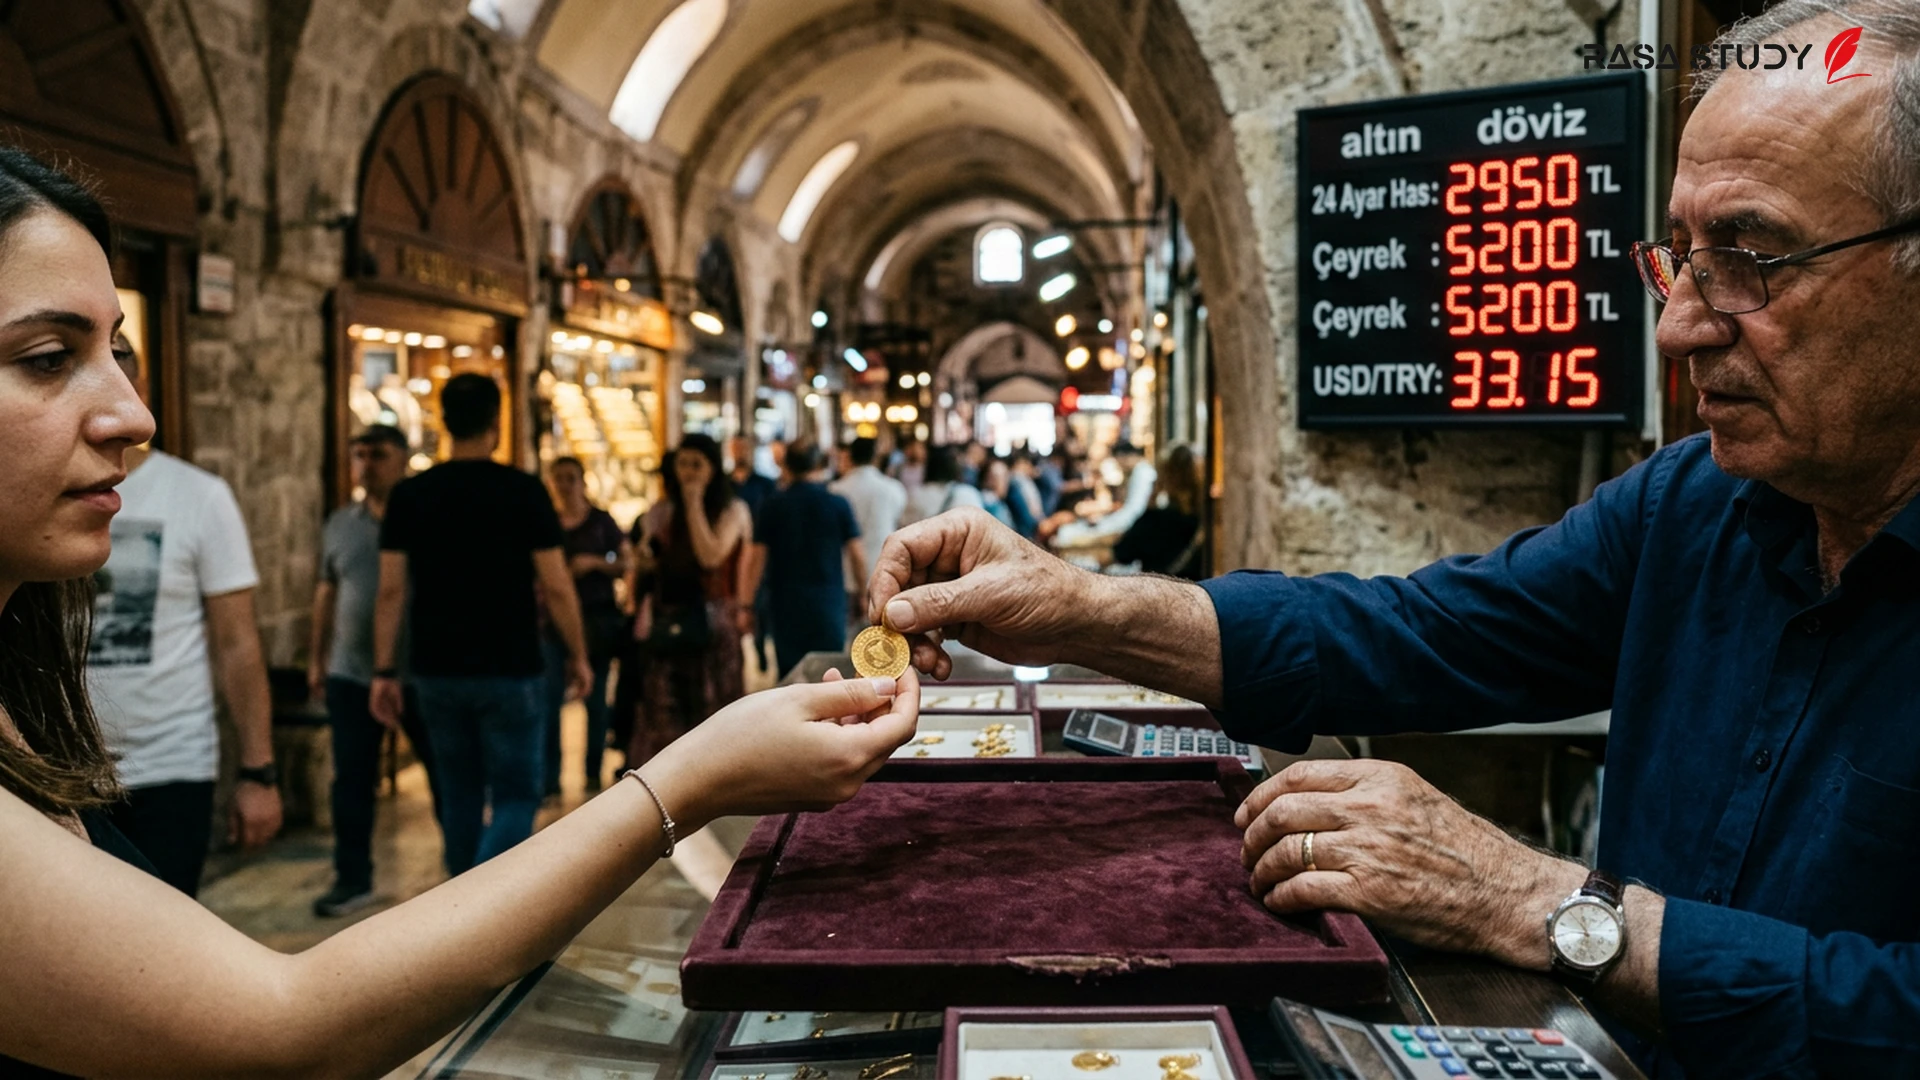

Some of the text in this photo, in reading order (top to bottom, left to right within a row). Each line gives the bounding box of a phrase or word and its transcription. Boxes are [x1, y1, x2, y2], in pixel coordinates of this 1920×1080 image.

[1340, 102, 1587, 159] altın döviz
[1312, 184, 1336, 214] 24
[1340, 182, 1387, 219] Ayar
[1445, 154, 1578, 215] 2950
[1586, 165, 1621, 194] TL
[1312, 237, 1407, 281] Çeyrek
[1445, 217, 1578, 276] 5200
[1586, 229, 1620, 258] TL
[1312, 296, 1407, 338] Çeyrek
[1445, 280, 1578, 336] 5200
[1585, 292, 1619, 321] TL
[1313, 362, 1444, 396] USD/TRY:
